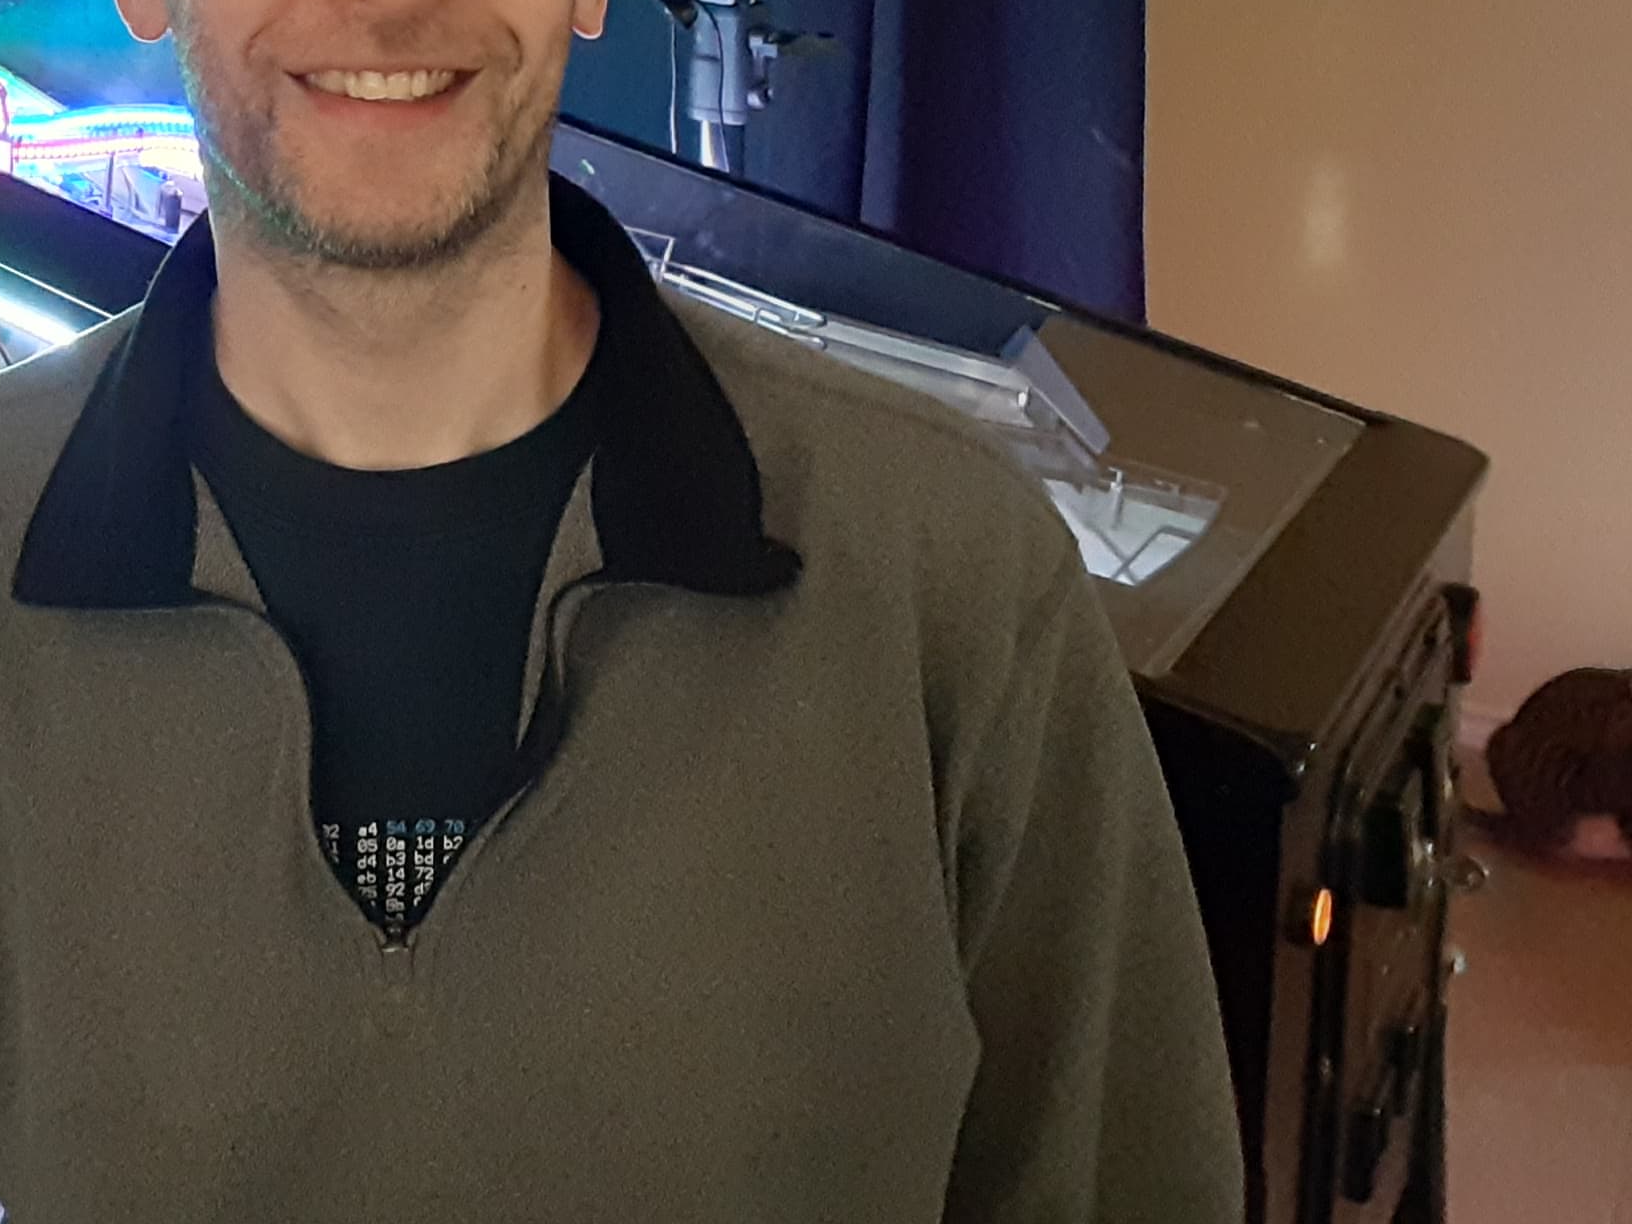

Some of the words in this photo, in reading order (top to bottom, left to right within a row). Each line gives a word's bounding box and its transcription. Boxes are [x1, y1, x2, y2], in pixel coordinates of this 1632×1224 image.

[416, 836, 434, 850] 1d
[357, 854, 378, 869] d4
[386, 852, 406, 867] b3
[414, 851, 434, 865] bd
[415, 866, 434, 881] 72
[386, 882, 405, 897] 92
